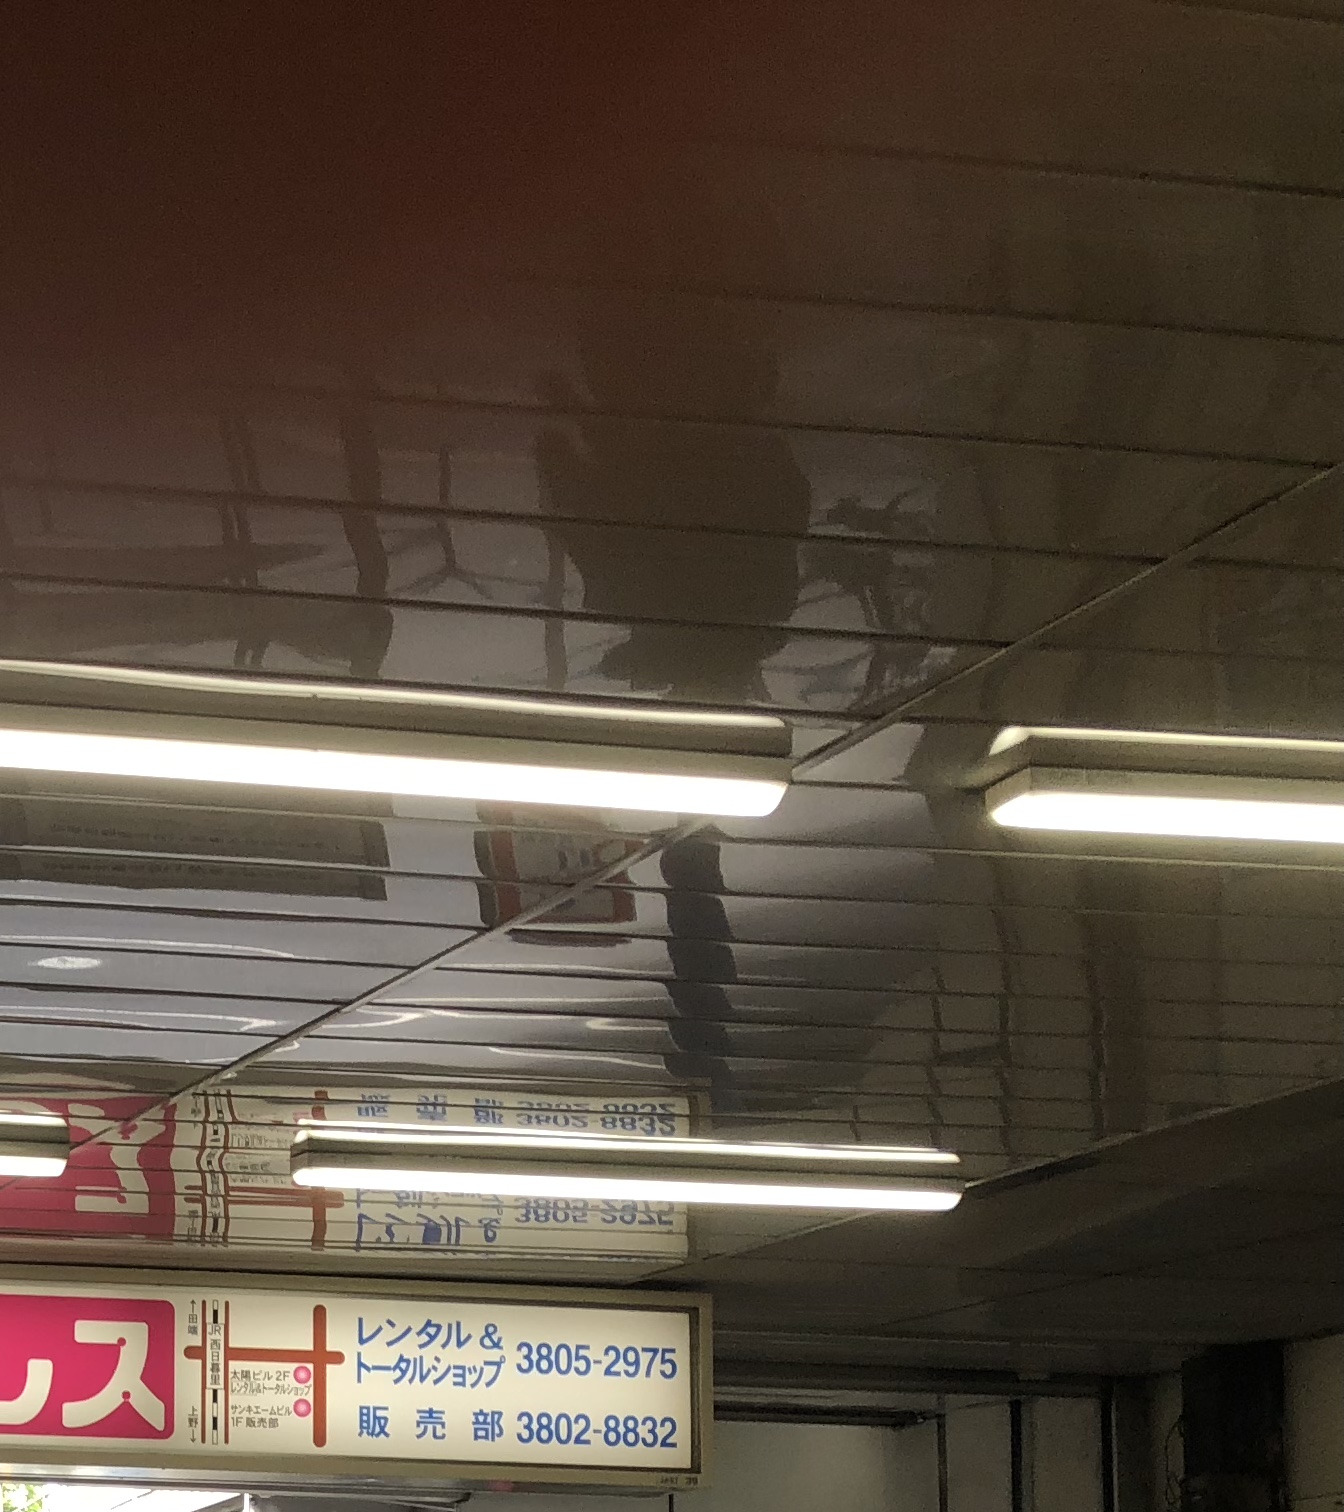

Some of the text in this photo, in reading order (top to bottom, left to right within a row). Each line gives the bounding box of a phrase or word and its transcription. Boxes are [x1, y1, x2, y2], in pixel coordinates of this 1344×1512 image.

[358, 1316, 503, 1352] レンタル &
[357, 1353, 505, 1389] トータルショップ
[516, 1341, 678, 1380] 3805-2975
[358, 1405, 504, 1441] 販売部
[516, 1411, 678, 1448] 3802-8832
